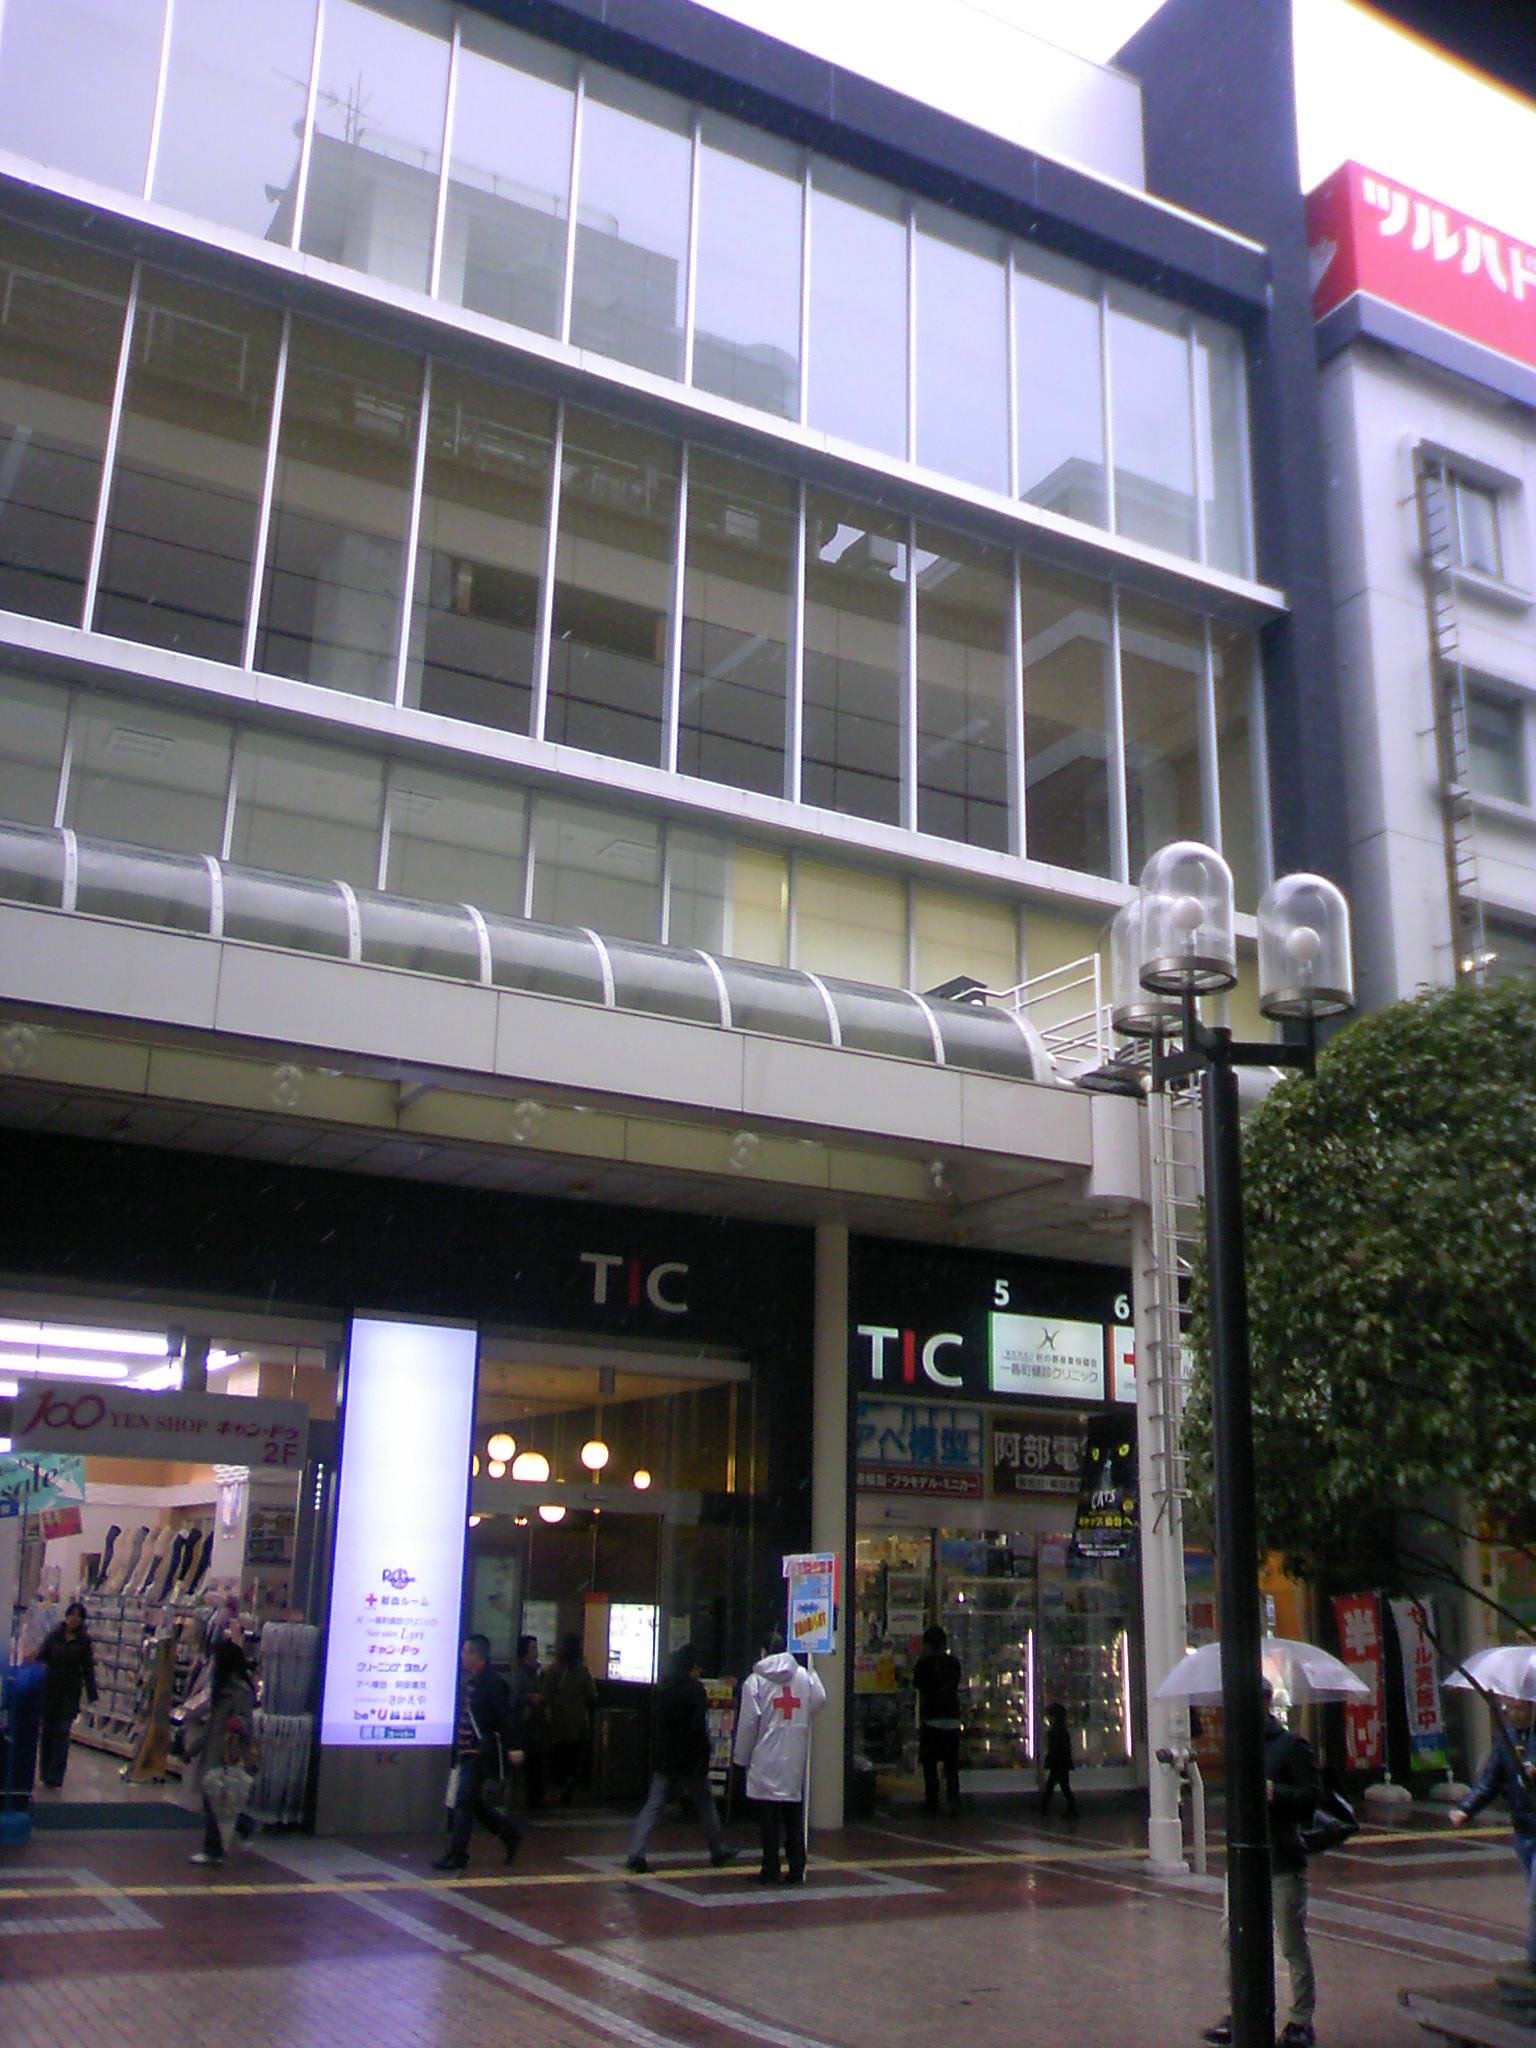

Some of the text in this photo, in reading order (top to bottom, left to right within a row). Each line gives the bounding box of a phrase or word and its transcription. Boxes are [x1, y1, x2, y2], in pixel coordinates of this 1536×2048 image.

[579, 1251, 690, 1315] TIC
[993, 1279, 1011, 1306] 5
[1113, 1294, 1130, 1320] 6
[857, 1324, 964, 1388] TIC
[22, 1389, 107, 1436] 100
[110, 1411, 150, 1430] YEN
[155, 1415, 208, 1434] SHOP
[263, 1441, 299, 1465] 2F
[994, 1431, 1086, 1472] 阿部電
